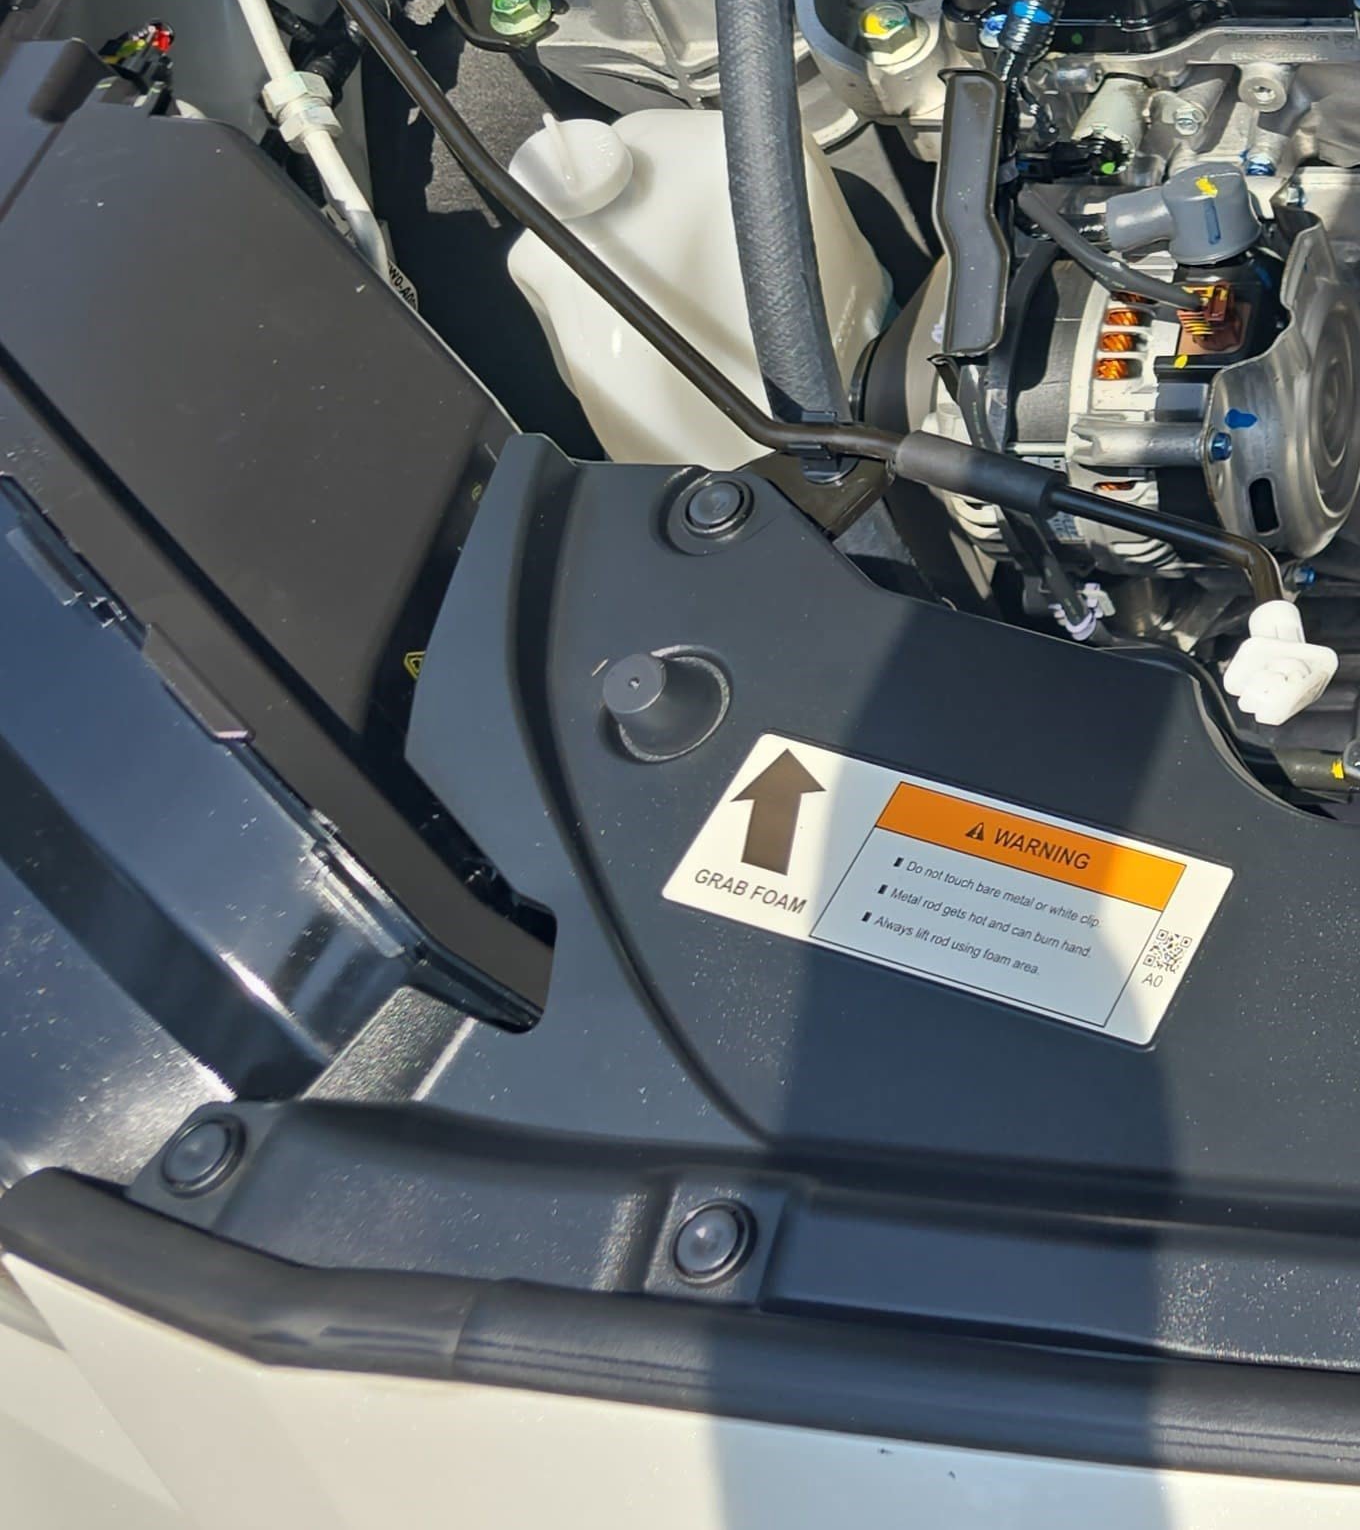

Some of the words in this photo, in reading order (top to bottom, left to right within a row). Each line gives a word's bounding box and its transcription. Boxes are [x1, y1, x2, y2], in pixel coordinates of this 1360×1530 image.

[994, 827, 1091, 870] WARNING
[694, 868, 749, 896] GRAB
[749, 885, 808, 914] FOAM
[890, 887, 922, 905] Metal
[922, 898, 943, 912] rod
[941, 905, 968, 921] gets
[968, 911, 988, 927] hot
[987, 918, 1012, 933] and
[1011, 926, 1033, 940] can
[1033, 931, 1060, 948] burn
[906, 860, 923, 874] Do
[924, 868, 944, 881] not
[943, 872, 975, 890] touch
[975, 881, 1001, 898] bare
[1002, 891, 1036, 907] metal
[1034, 900, 1049, 911] or
[1048, 905, 1079, 922] white
[873, 915, 914, 937] Always
[914, 926, 931, 942] lift
[929, 934, 952, 948] rod
[950, 939, 982, 959] using
[982, 948, 1012, 966] foam
[1012, 959, 1041, 975] area.
